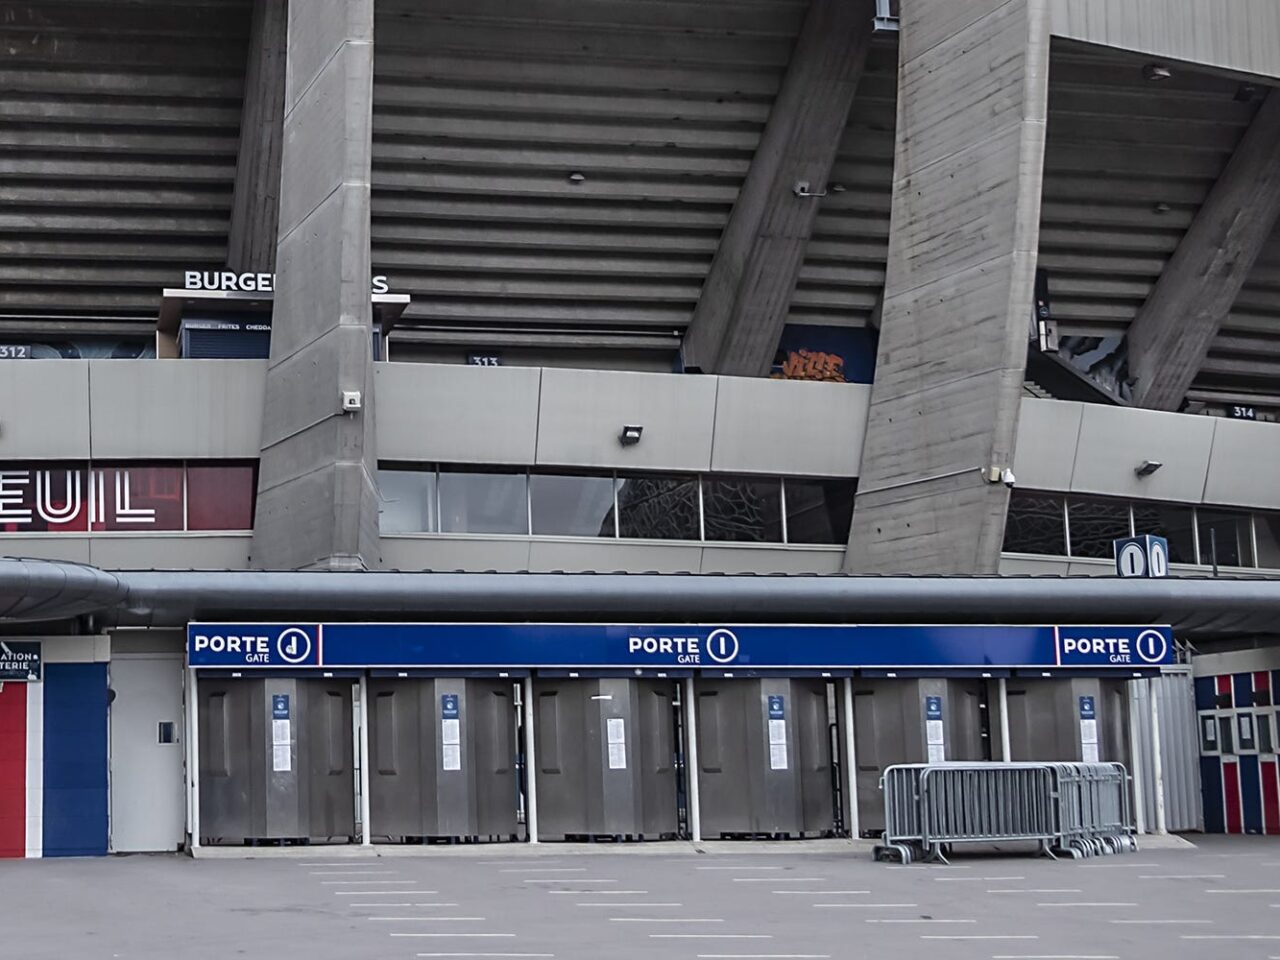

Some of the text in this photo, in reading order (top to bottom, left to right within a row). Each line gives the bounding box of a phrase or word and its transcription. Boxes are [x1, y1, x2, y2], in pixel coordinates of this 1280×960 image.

[184, 271, 276, 291] BURGE
[0, 345, 26, 358] 312
[473, 356, 498, 367] 313
[1233, 406, 1254, 417] 314
[194, 635, 270, 653] PORTE
[628, 637, 700, 654] PORTE
[1063, 638, 1131, 654] PORTE
[245, 653, 270, 663] GATE
[677, 654, 700, 664] GATE
[1109, 654, 1131, 663] GATE
